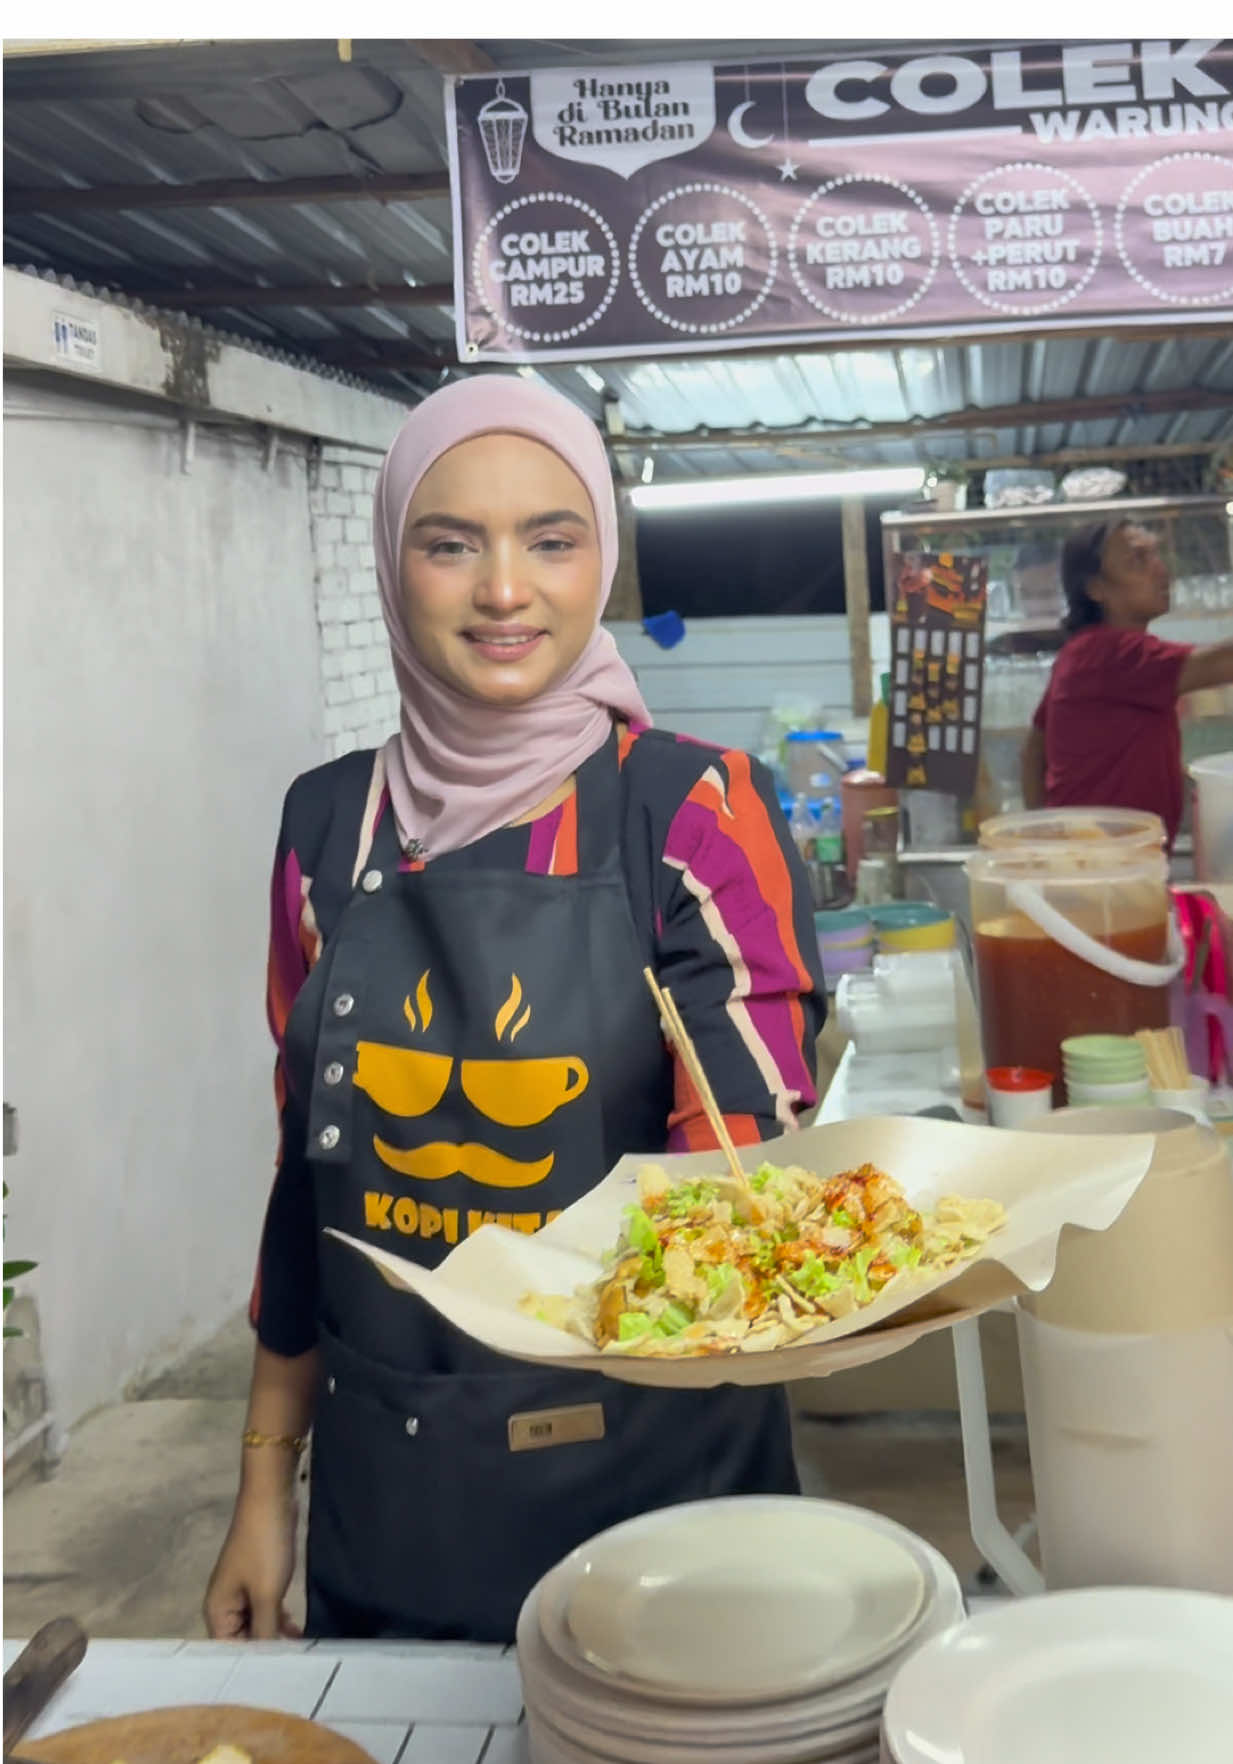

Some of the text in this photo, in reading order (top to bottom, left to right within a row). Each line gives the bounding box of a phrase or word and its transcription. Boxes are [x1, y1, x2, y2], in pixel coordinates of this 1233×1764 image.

[573, 78, 670, 101] Hanya
[805, 39, 1231, 120] COLEK
[557, 95, 690, 124] di Bulan
[552, 119, 695, 147] Ramadan
[975, 189, 1071, 216] COLEK
[656, 221, 746, 247] COLEK
[815, 210, 909, 238] COLEK
[985, 213, 1064, 240] PARU
[1152, 215, 1233, 242] BUAH
[501, 229, 591, 257] COLEK
[806, 235, 922, 265] KERANG
[971, 238, 1081, 267] +PERUT
[1164, 241, 1226, 268] RM7
[489, 254, 605, 283] CAMPUR
[660, 246, 744, 273] AYAM
[665, 271, 742, 299] RM10
[825, 263, 905, 290] RM10
[987, 264, 1068, 293] RM10
[510, 281, 585, 307] RM25
[363, 1190, 460, 1244] KOPI
